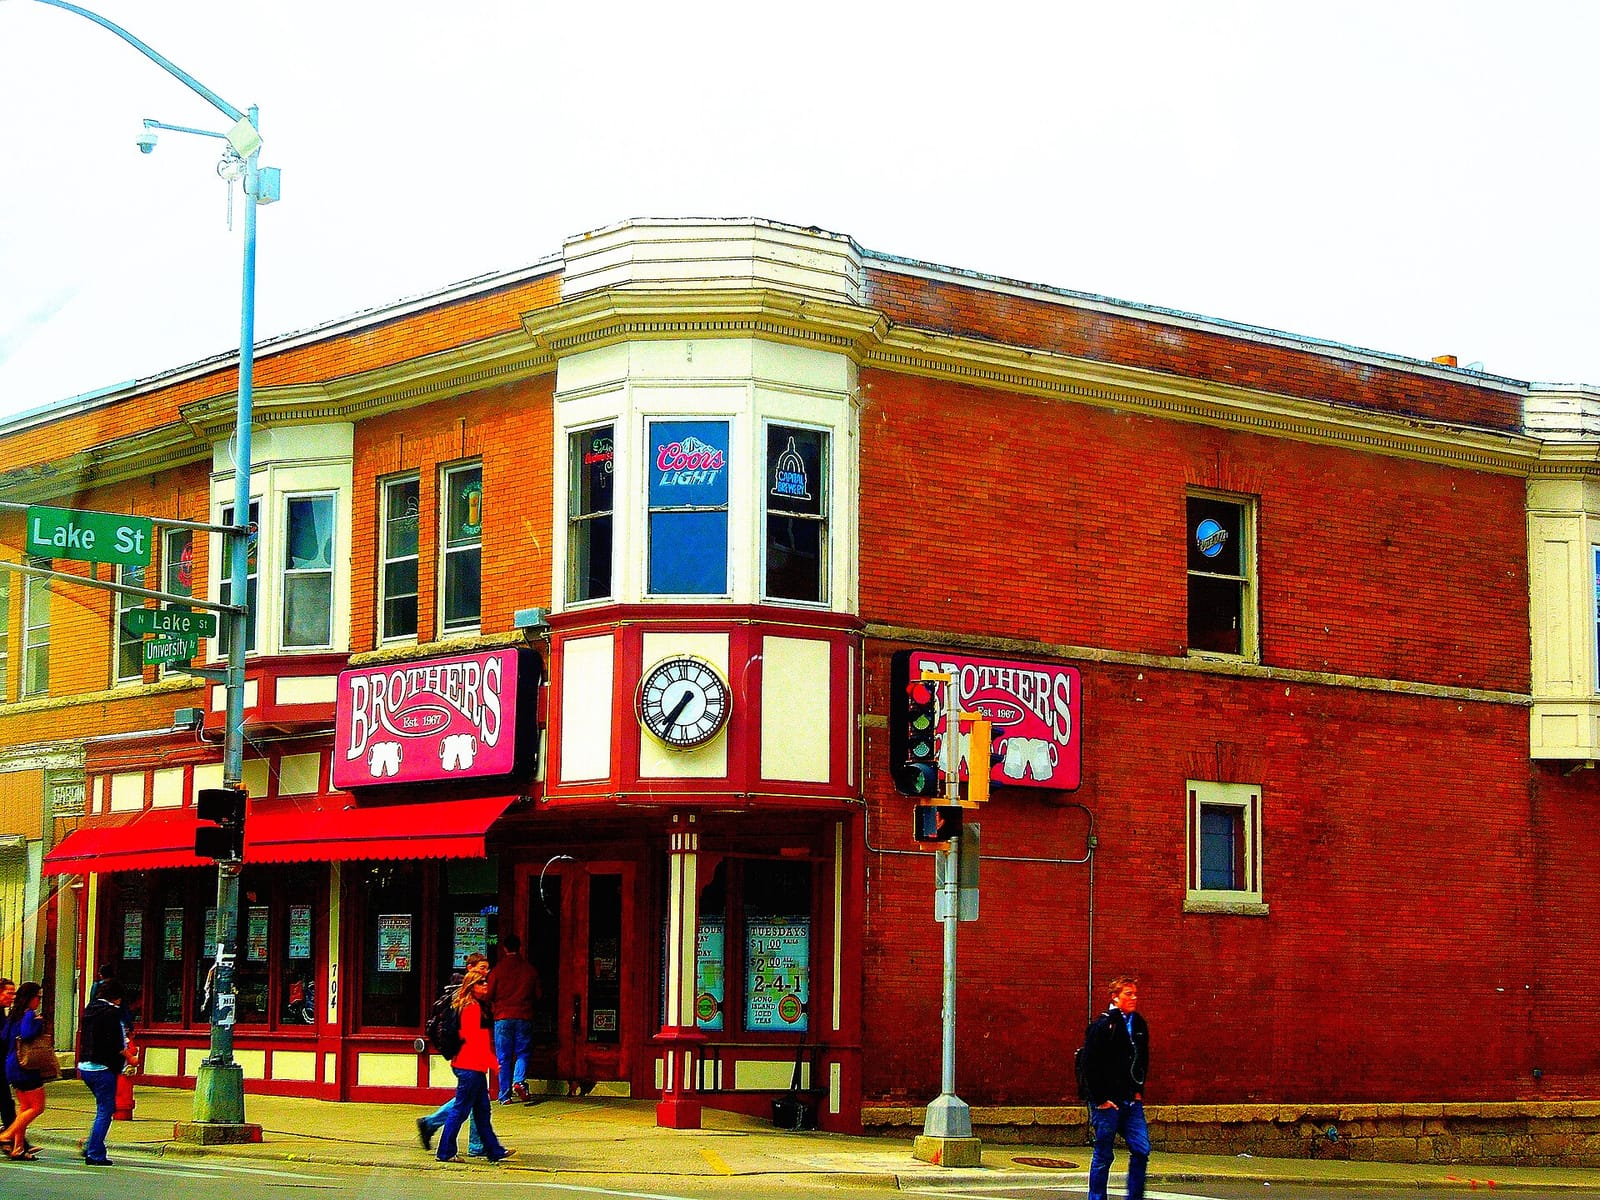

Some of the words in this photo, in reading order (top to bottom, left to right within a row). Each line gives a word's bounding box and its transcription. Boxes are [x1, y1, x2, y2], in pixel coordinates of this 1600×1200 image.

[657, 442, 725, 471] Coors
[659, 470, 720, 487] LIGHT
[33, 518, 96, 550] Lake
[114, 526, 145, 555] St
[138, 614, 144, 624] N
[153, 612, 191, 631] Lake
[199, 619, 208, 629] St
[147, 638, 188, 659] University
[346, 656, 502, 760] BROTHERS
[978, 707, 994, 717] Est.
[997, 709, 1016, 719] 1967
[403, 717, 419, 729] Est.
[422, 714, 442, 726] 1967
[751, 927, 807, 937] TUESDAYS
[754, 975, 802, 993] 2-4-1
